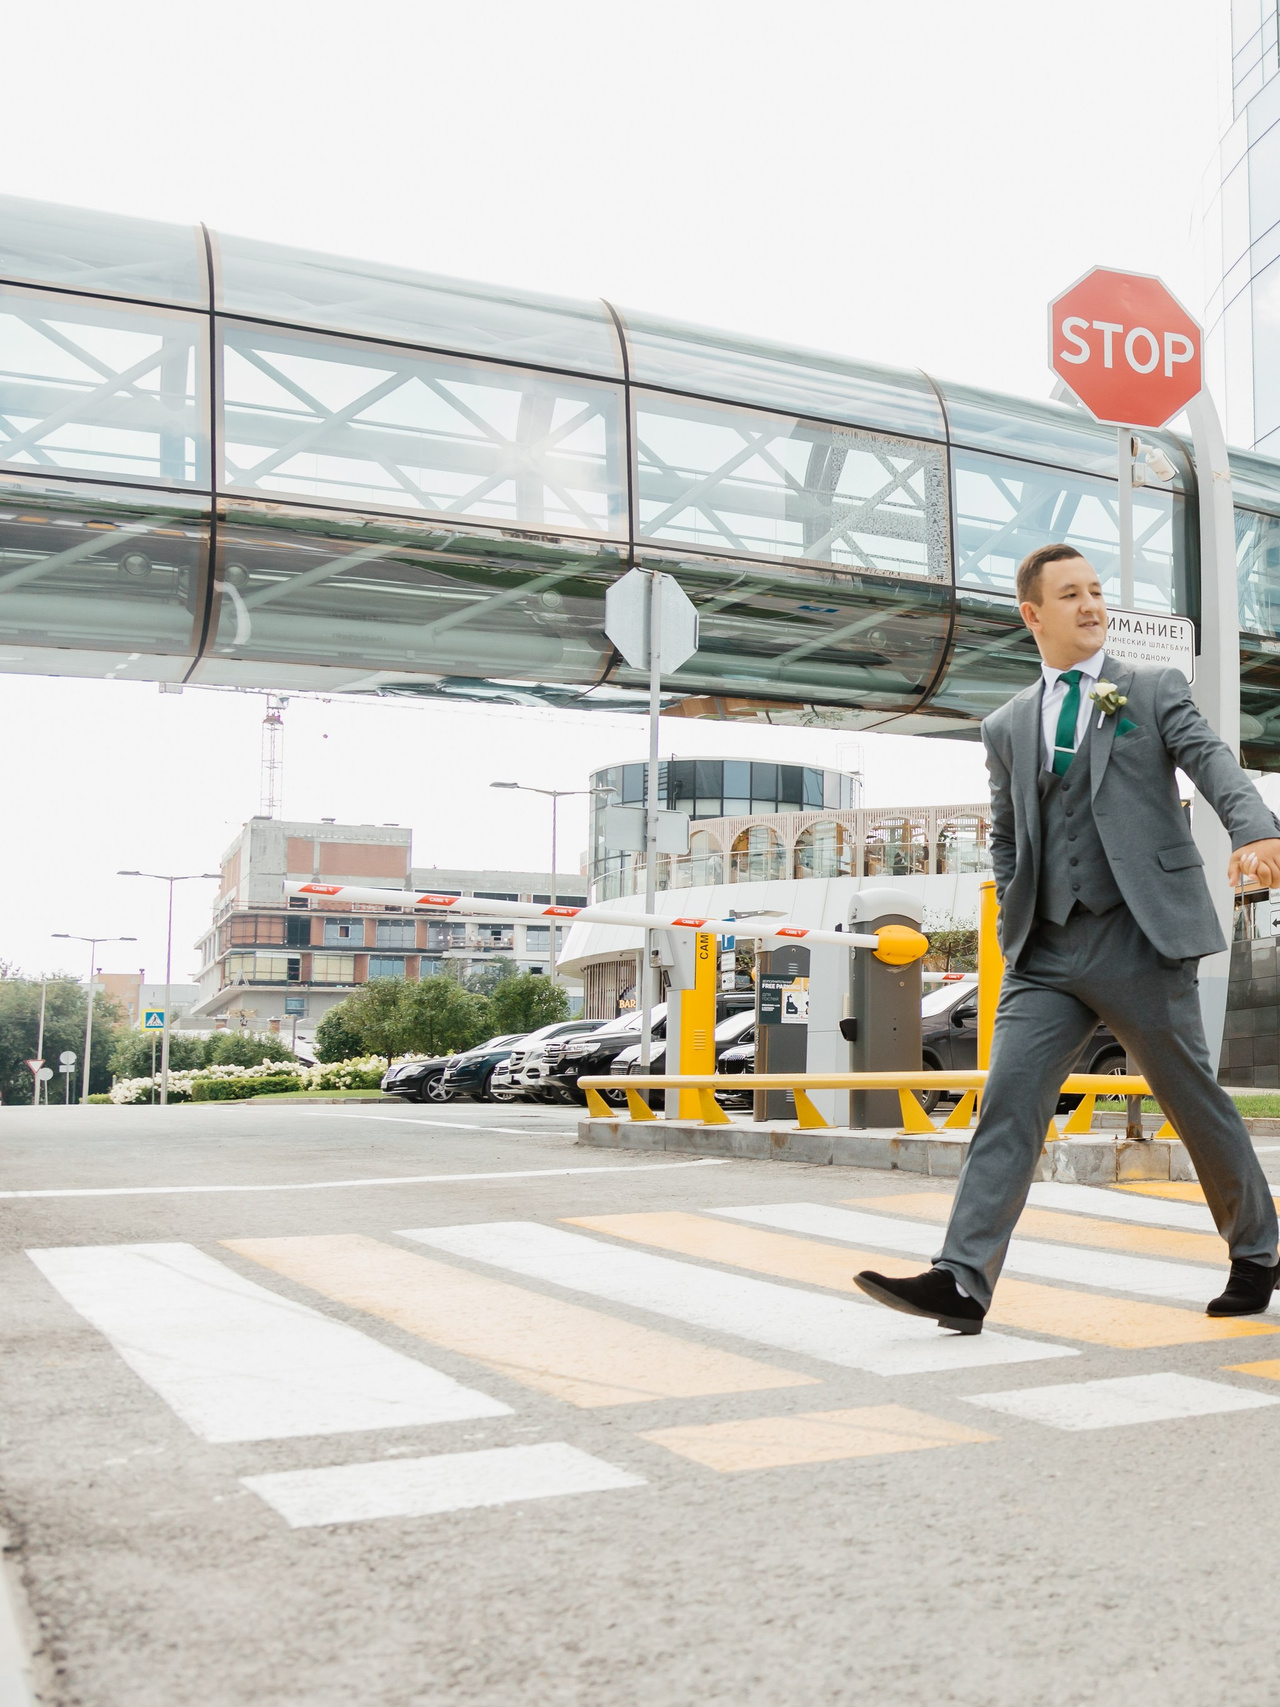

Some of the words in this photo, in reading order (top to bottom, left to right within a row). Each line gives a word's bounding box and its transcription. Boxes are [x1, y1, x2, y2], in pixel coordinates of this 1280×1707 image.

[1060, 316, 1195, 377] STOP
[1107, 616, 1184, 640] ИМАНИЕ!
[1141, 653, 1171, 662] ОДНОМУ
[1149, 641, 1190, 653] ШЛАГБАУМ
[700, 932, 709, 960] CAM
